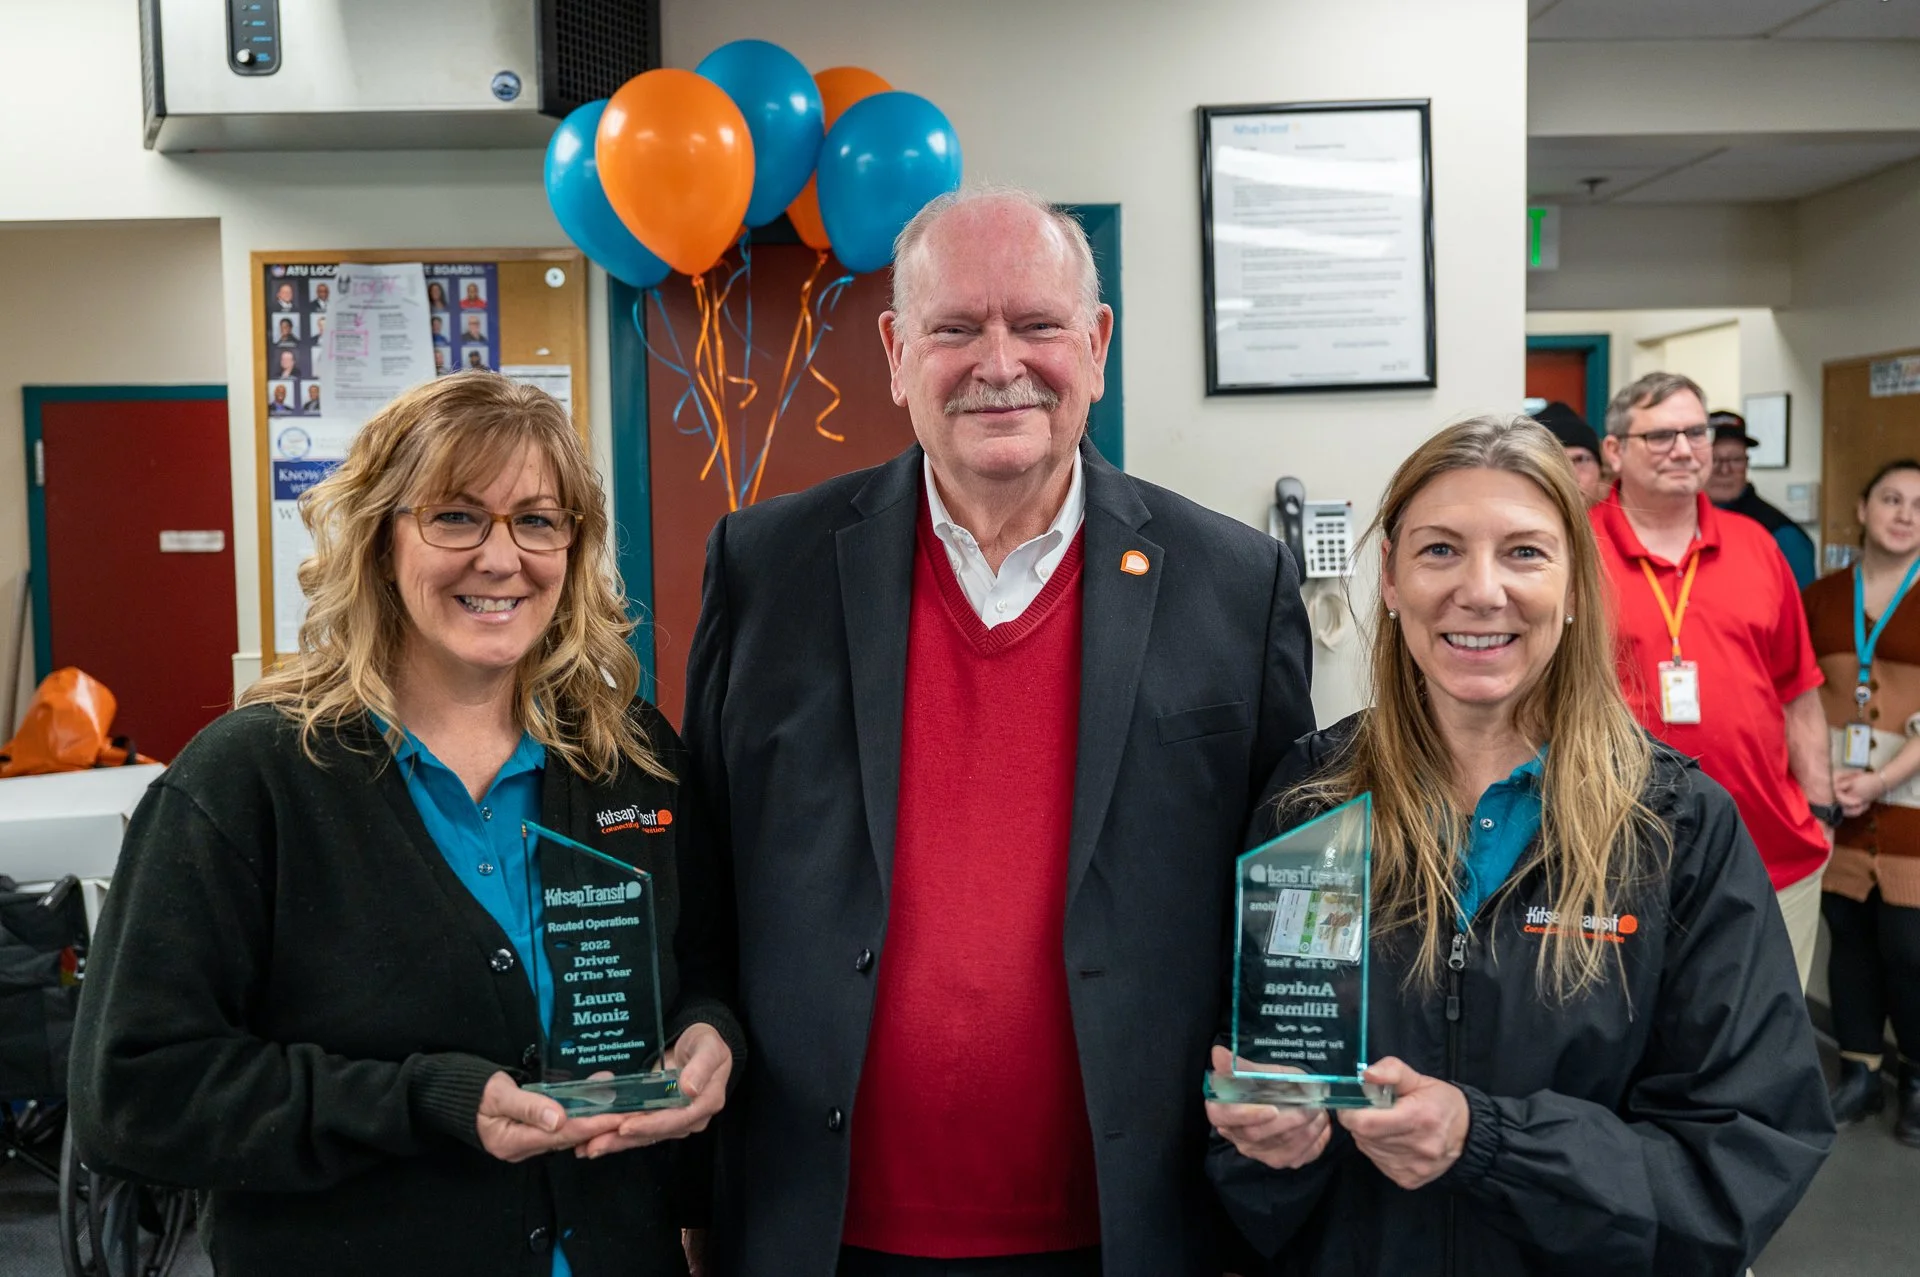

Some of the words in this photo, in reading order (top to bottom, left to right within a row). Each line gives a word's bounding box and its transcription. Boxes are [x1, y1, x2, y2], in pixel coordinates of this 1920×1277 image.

[285, 265, 308, 277] ATU
[309, 265, 338, 277] LOC
[433, 264, 473, 276] BOARD
[279, 469, 320, 481] KNOW
[548, 920, 584, 933] Routed
[585, 916, 640, 931] Operations
[580, 940, 611, 952] 2022
[574, 955, 620, 968] Driver
[563, 972, 580, 983] Of
[580, 970, 603, 981] The
[605, 968, 632, 978] Year
[572, 991, 627, 1007] Laura
[572, 1008, 630, 1026] Moniz
[561, 1047, 576, 1056] For
[576, 1044, 598, 1054] Your
[599, 1040, 645, 1051] Dedication
[577, 1056, 597, 1065] And
[598, 1052, 631, 1063] Service
